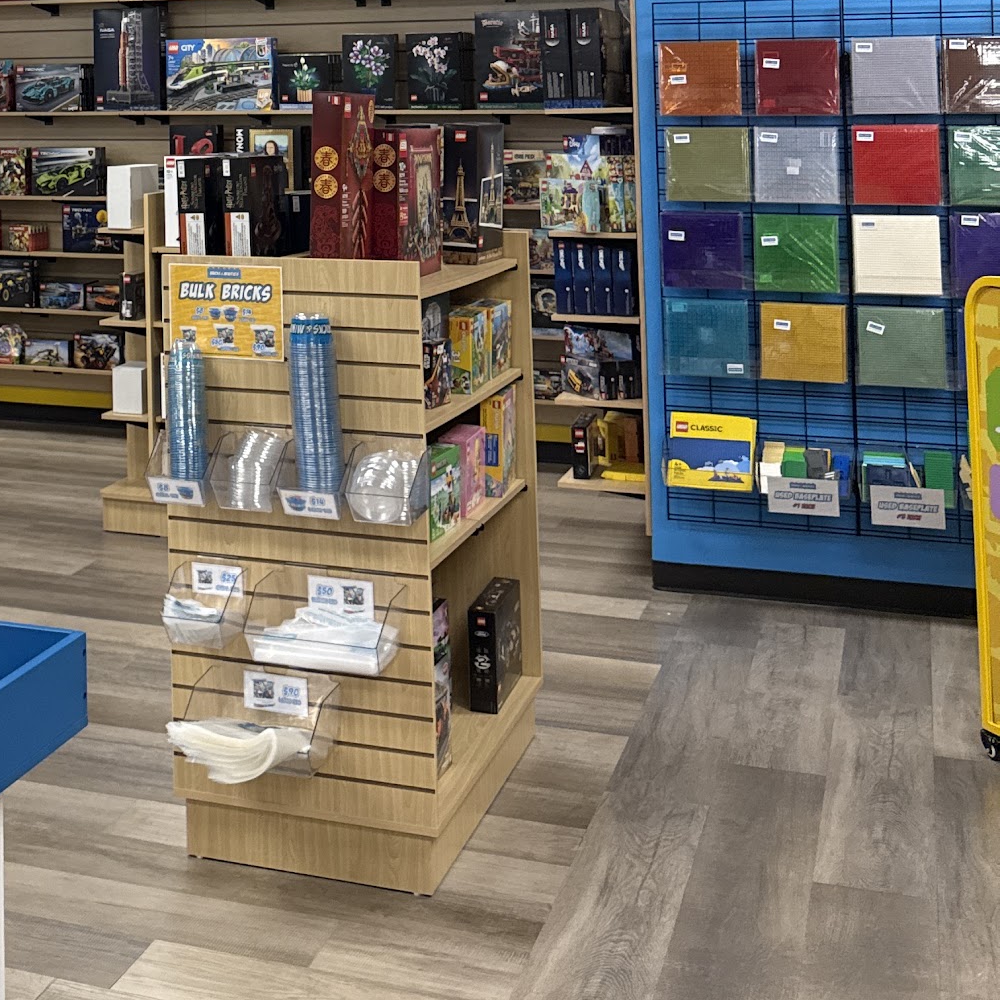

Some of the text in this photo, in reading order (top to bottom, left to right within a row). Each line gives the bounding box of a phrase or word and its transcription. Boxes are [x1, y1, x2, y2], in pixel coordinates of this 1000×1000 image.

[180, 44, 196, 52] CITY
[179, 281, 272, 303] BULK BRICKS
[690, 424, 724, 433] CLASSIC
[774, 491, 833, 502] USED BASEPLATE
[878, 501, 939, 513] USED BASEPLATE
[316, 585, 334, 596] $50
[283, 686, 300, 697] $90
